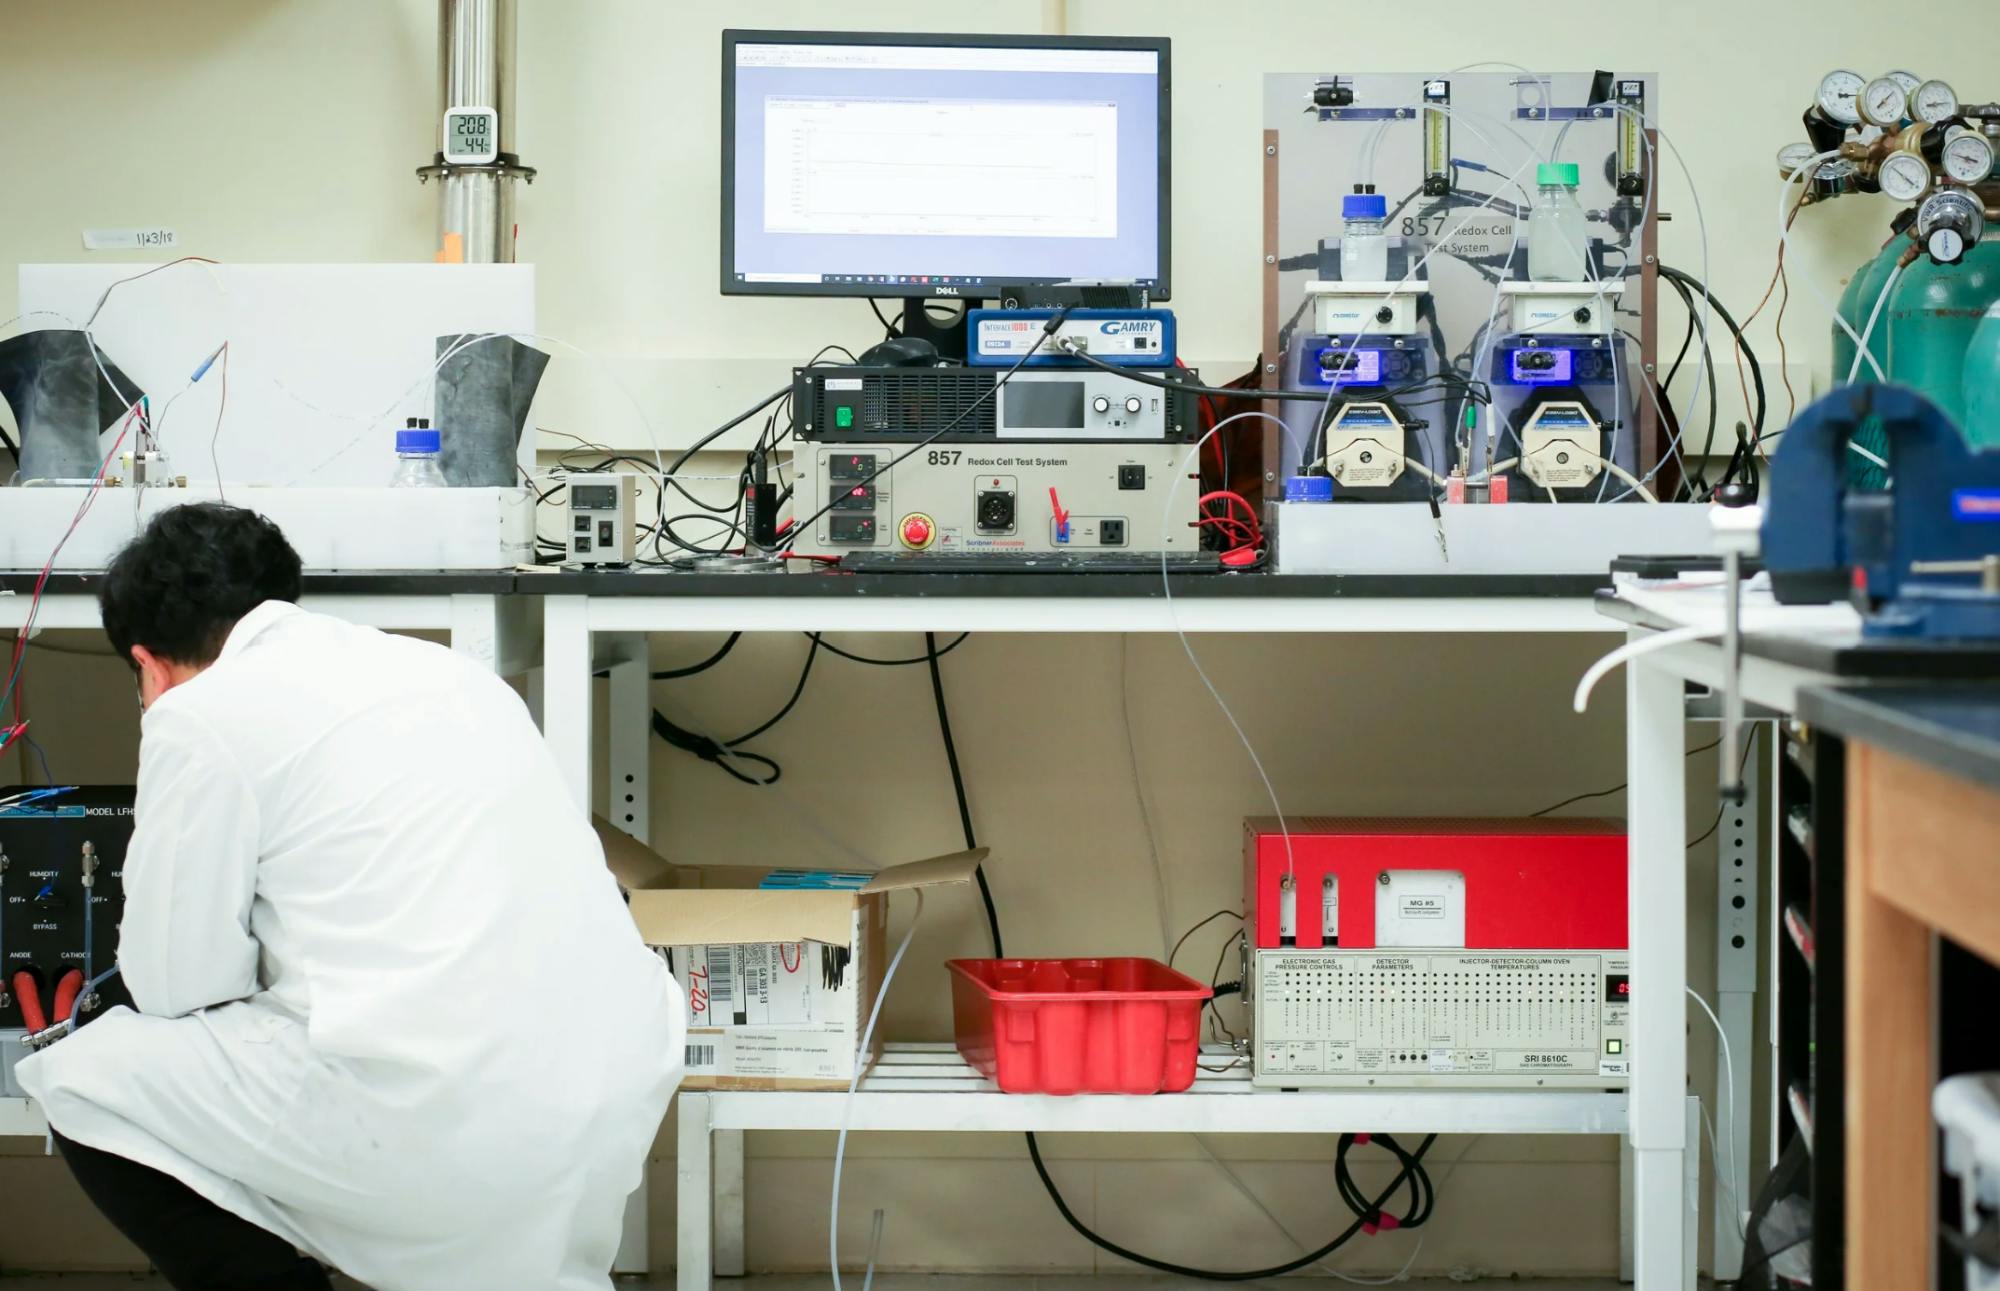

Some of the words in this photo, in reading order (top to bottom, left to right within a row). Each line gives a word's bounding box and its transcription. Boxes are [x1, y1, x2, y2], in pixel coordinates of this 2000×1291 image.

[466, 138, 484, 153] 44
[1921, 201, 1935, 222] VWR
[1936, 197, 1973, 214] Scientific
[1401, 217, 1446, 237] 857
[1491, 225, 1512, 236] Cell
[1424, 242, 1448, 253] Test
[1452, 242, 1489, 254] System
[936, 287, 959, 295] DELL
[1100, 321, 1156, 335] GAMRY
[927, 450, 962, 466] 857
[967, 457, 995, 466] Redox
[996, 457, 1013, 466] Cell
[1015, 457, 1033, 466] Test
[1035, 457, 1068, 468] System
[86, 807, 114, 816] MODEL
[759, 967, 768, 977] GA
[688, 965, 708, 1012] 7-20
[759, 978, 768, 990] 303
[759, 990, 768, 1004] 3-13
[1524, 1054, 1540, 1063] SRI
[1541, 1054, 1568, 1063] 8610C
